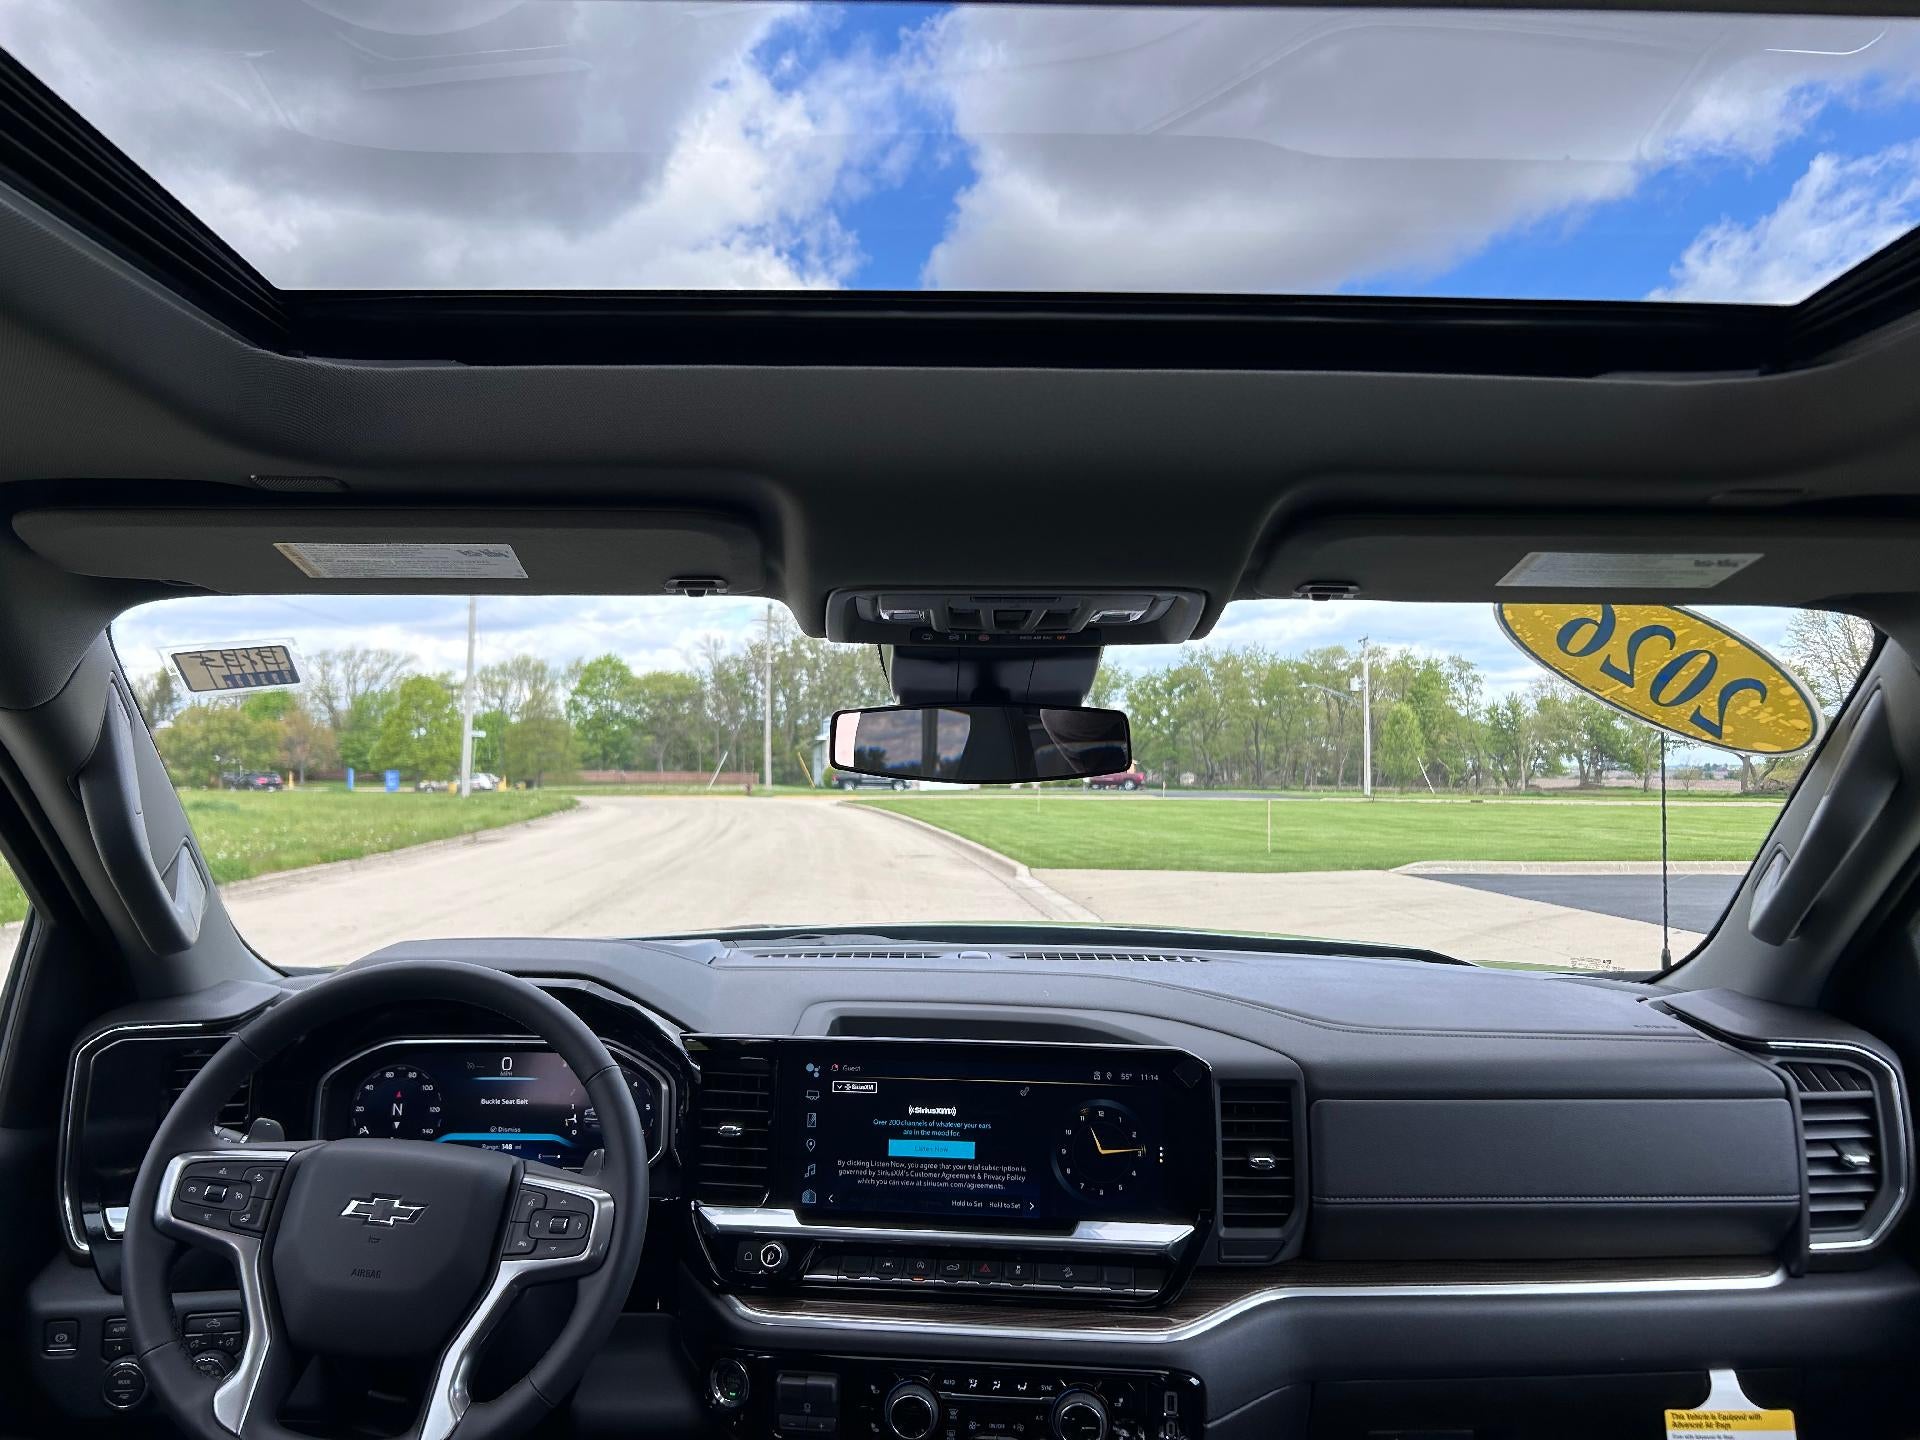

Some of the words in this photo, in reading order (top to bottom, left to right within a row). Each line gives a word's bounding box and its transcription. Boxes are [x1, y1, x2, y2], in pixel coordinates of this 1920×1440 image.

[502, 1056, 513, 1071] 0
[392, 1103, 403, 1116] N
[936, 1120, 963, 1128] whatever
[846, 1160, 870, 1168] clicking
[870, 1160, 890, 1168] Listen
[953, 1163, 966, 1171] your
[838, 1169, 868, 1177] governed
[868, 1169, 876, 1177] by
[909, 1170, 940, 1178] Customer
[940, 1171, 976, 1180] Agreement
[983, 1172, 1005, 1182] Privacy
[1006, 1173, 1026, 1182] Policy
